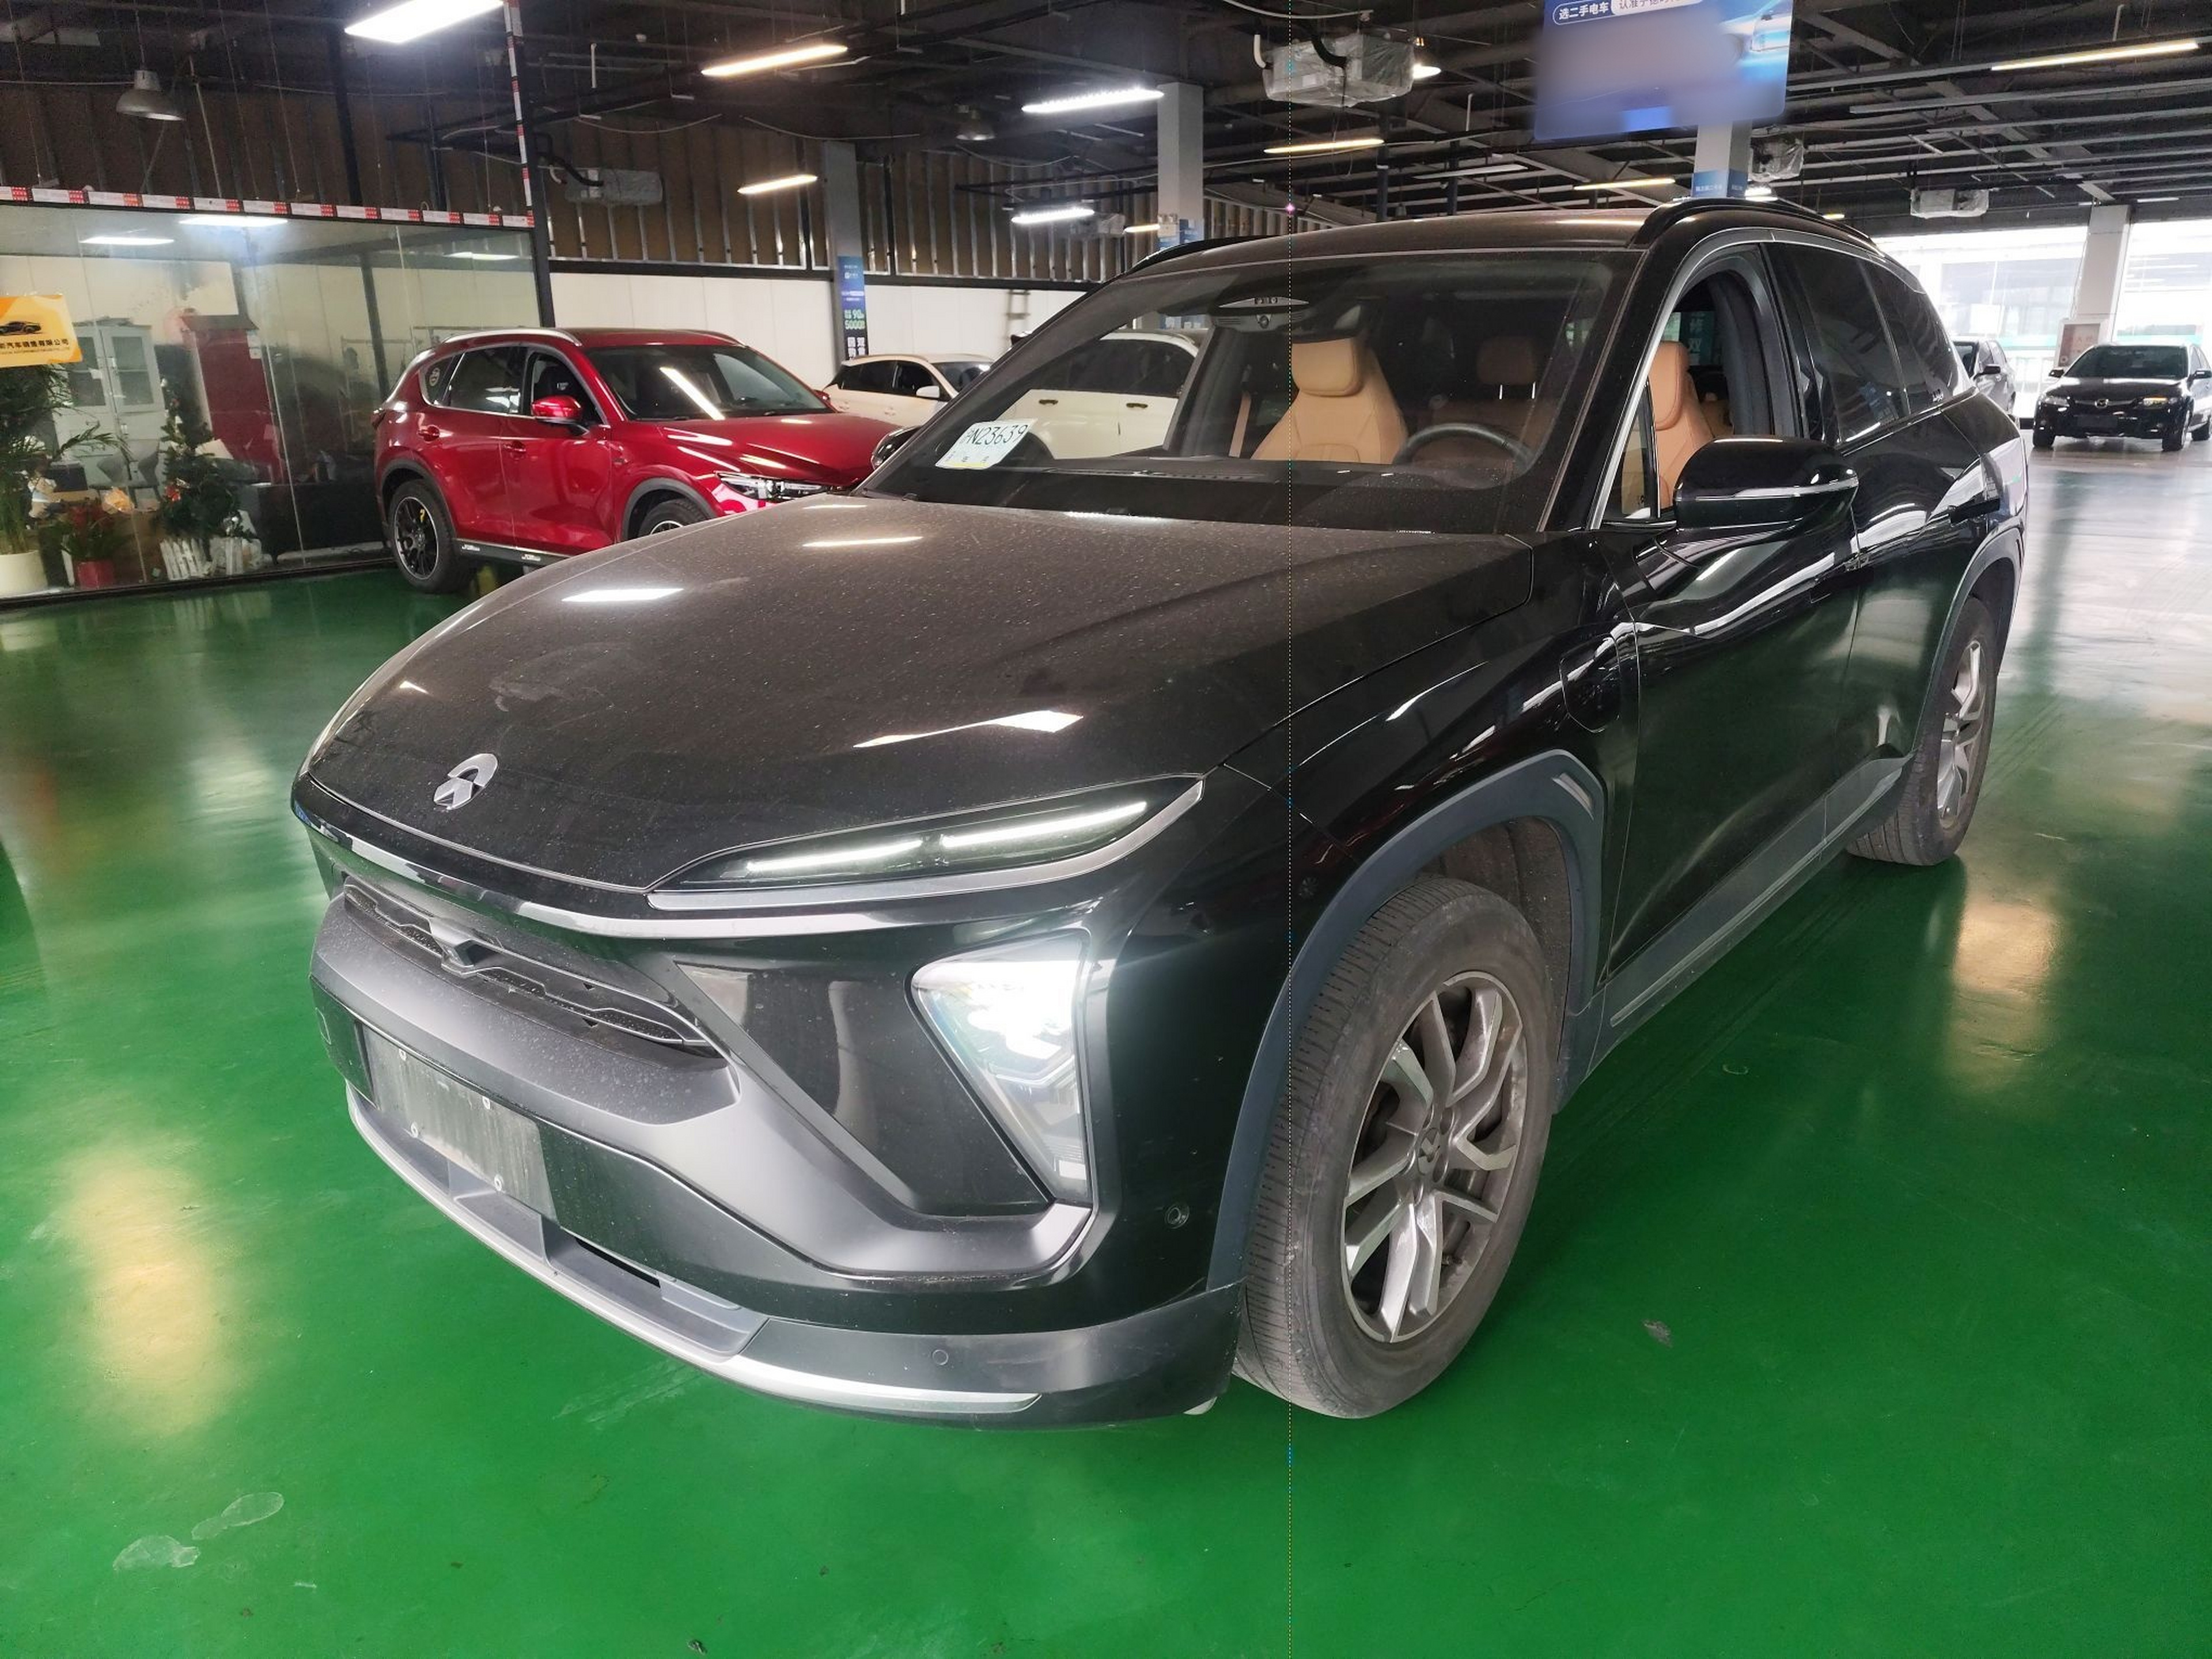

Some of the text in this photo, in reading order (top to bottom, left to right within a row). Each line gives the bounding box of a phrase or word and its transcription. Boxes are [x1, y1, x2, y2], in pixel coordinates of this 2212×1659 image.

[1559, 2, 1609, 20] 选二手电车
